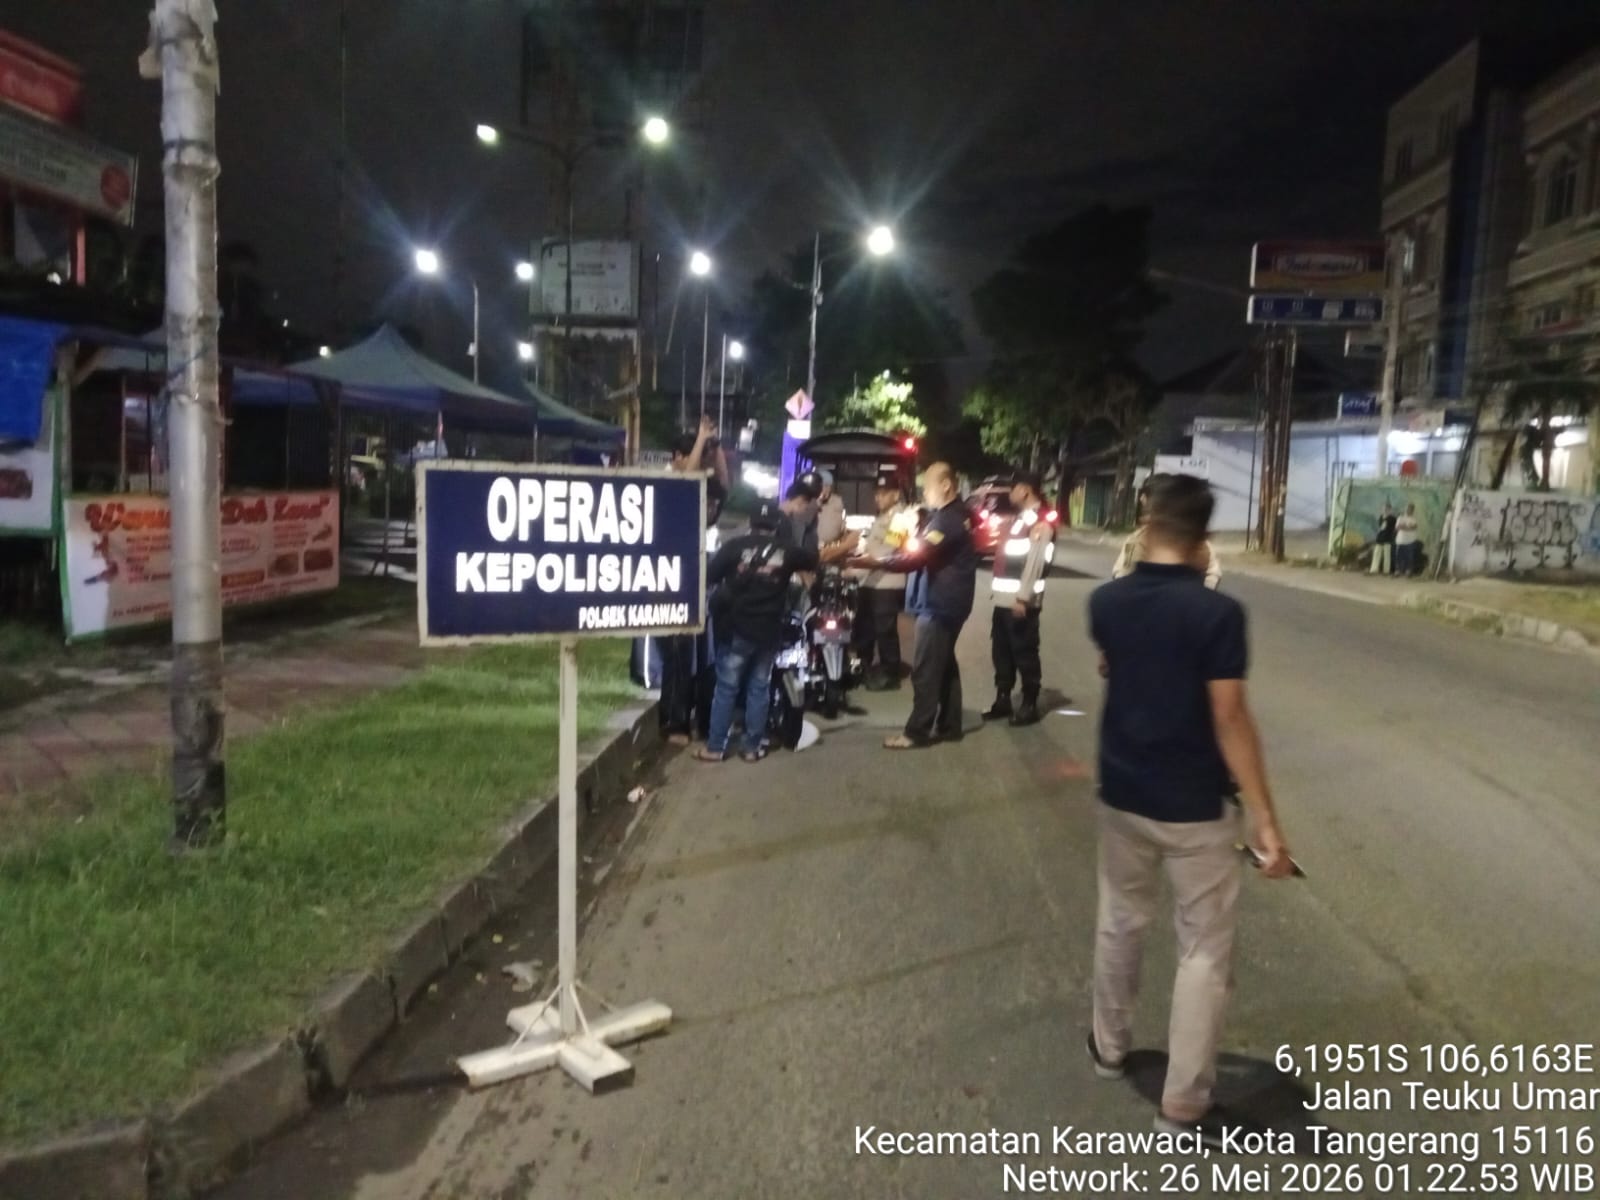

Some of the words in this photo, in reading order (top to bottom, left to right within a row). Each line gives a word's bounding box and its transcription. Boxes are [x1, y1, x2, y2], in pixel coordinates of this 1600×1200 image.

[487, 477, 655, 545] OPERASI
[455, 552, 681, 593] KEPOLISIAN
[578, 605, 626, 629] POLSEK
[628, 603, 689, 627] KARAWACI
